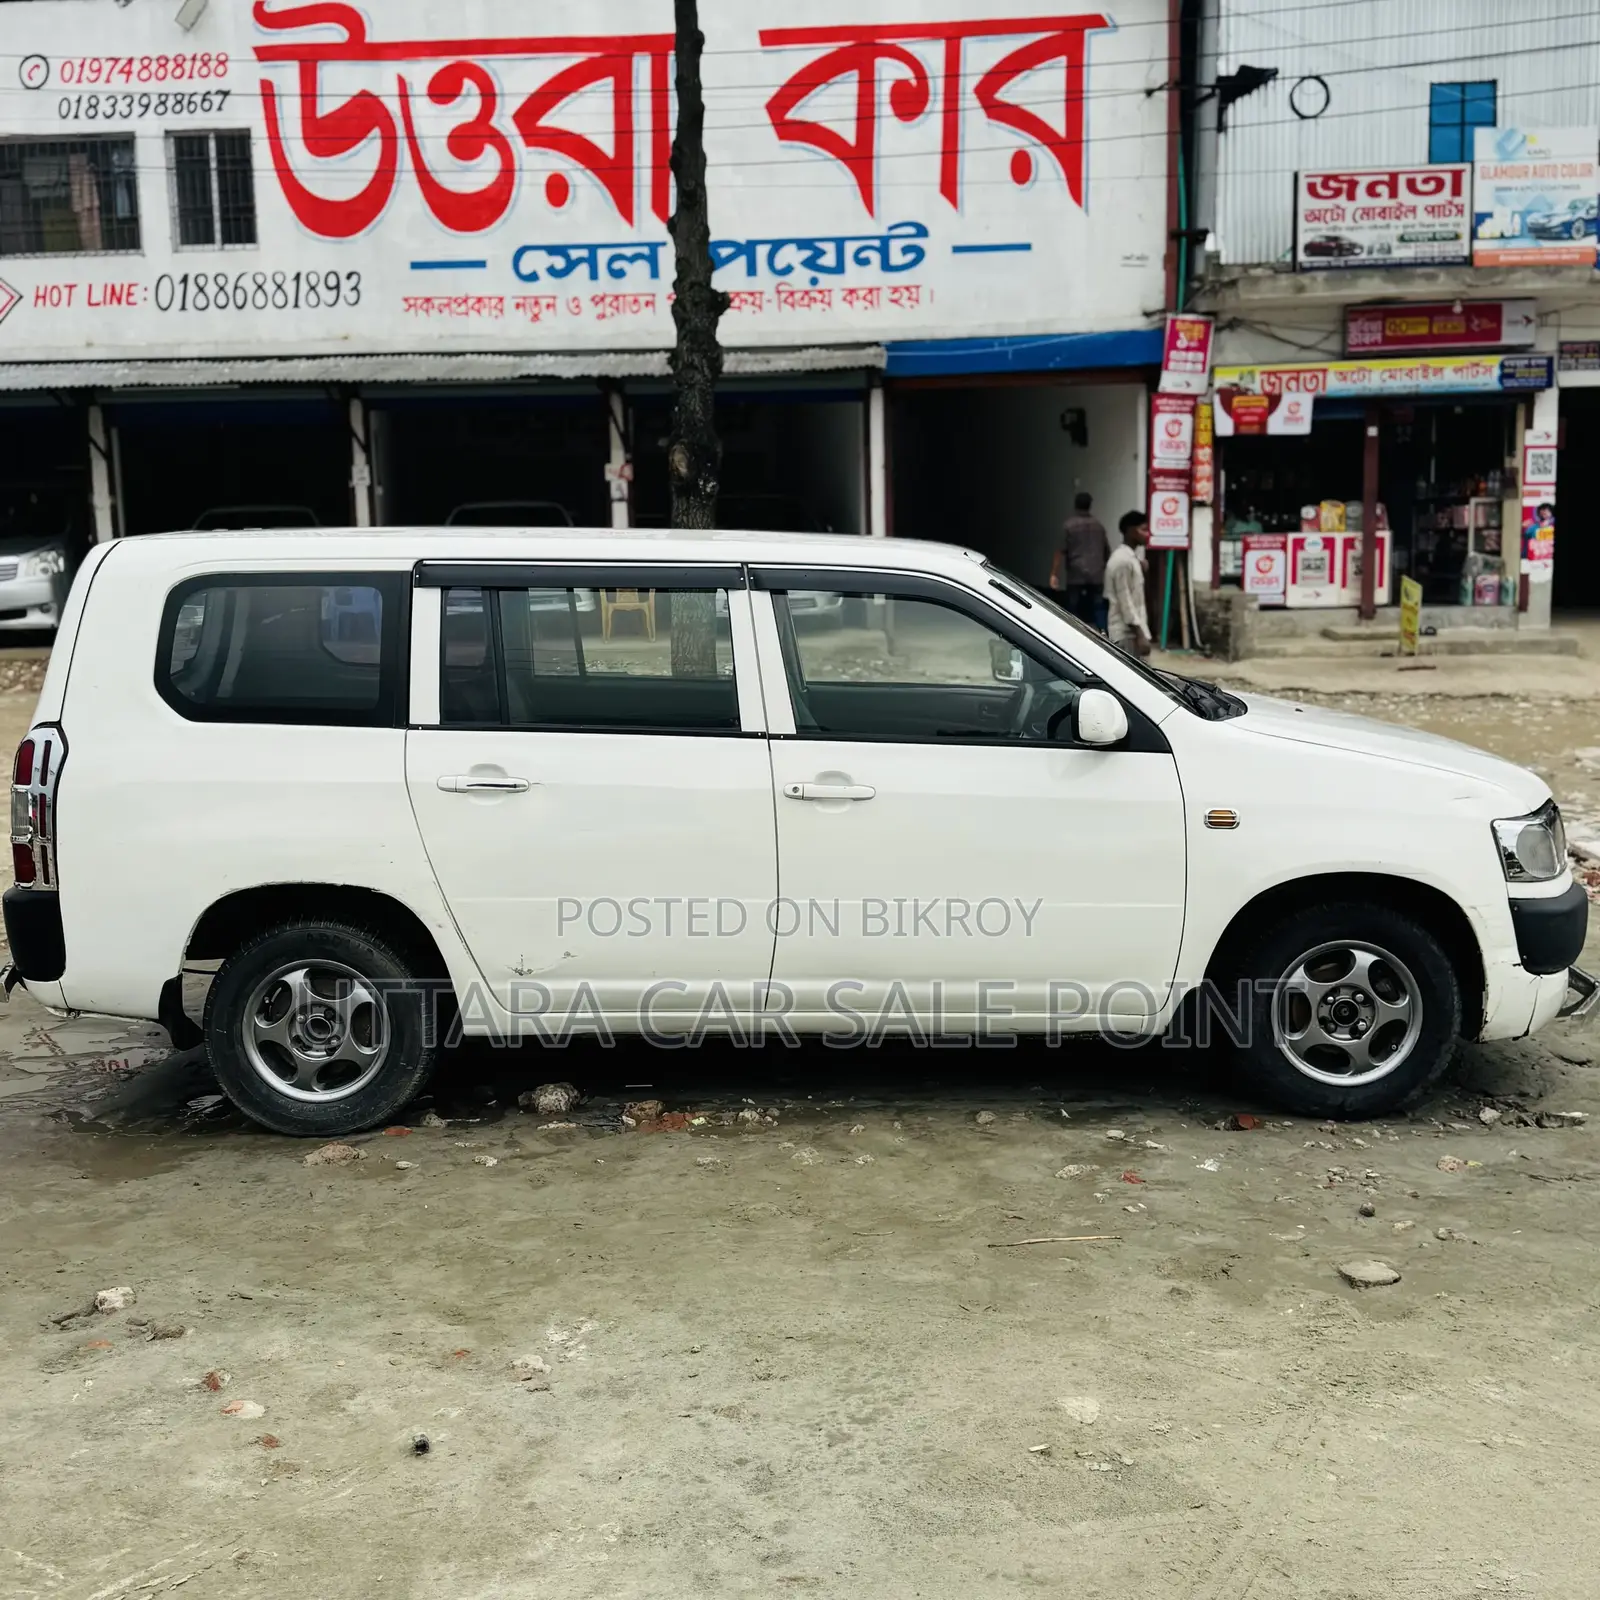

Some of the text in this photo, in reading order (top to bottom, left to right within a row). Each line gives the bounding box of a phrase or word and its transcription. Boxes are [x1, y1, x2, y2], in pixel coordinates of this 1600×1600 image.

[60, 52, 229, 84] 01974888188
[58, 89, 231, 119] 01833988667
[252, 0, 1108, 238] উত্তরা কার
[1305, 170, 1465, 201] জনতা
[1532, 164, 1558, 178] AUTO
[1304, 205, 1345, 224] অটো
[1352, 201, 1417, 223] মোবাইল
[512, 221, 929, 286] সেল পয়েন্ট
[33, 271, 362, 311] HOT LINE: 01886881893
[402, 296, 504, 319] সকলপ্রকার
[511, 295, 557, 322] নতুন
[566, 298, 582, 316] ও
[590, 293, 657, 319] পুরাতন
[841, 286, 882, 312] করা
[1260, 368, 1329, 396] জনতা
[1334, 366, 1372, 384] অটো
[1380, 362, 1445, 383] মোবাইল
